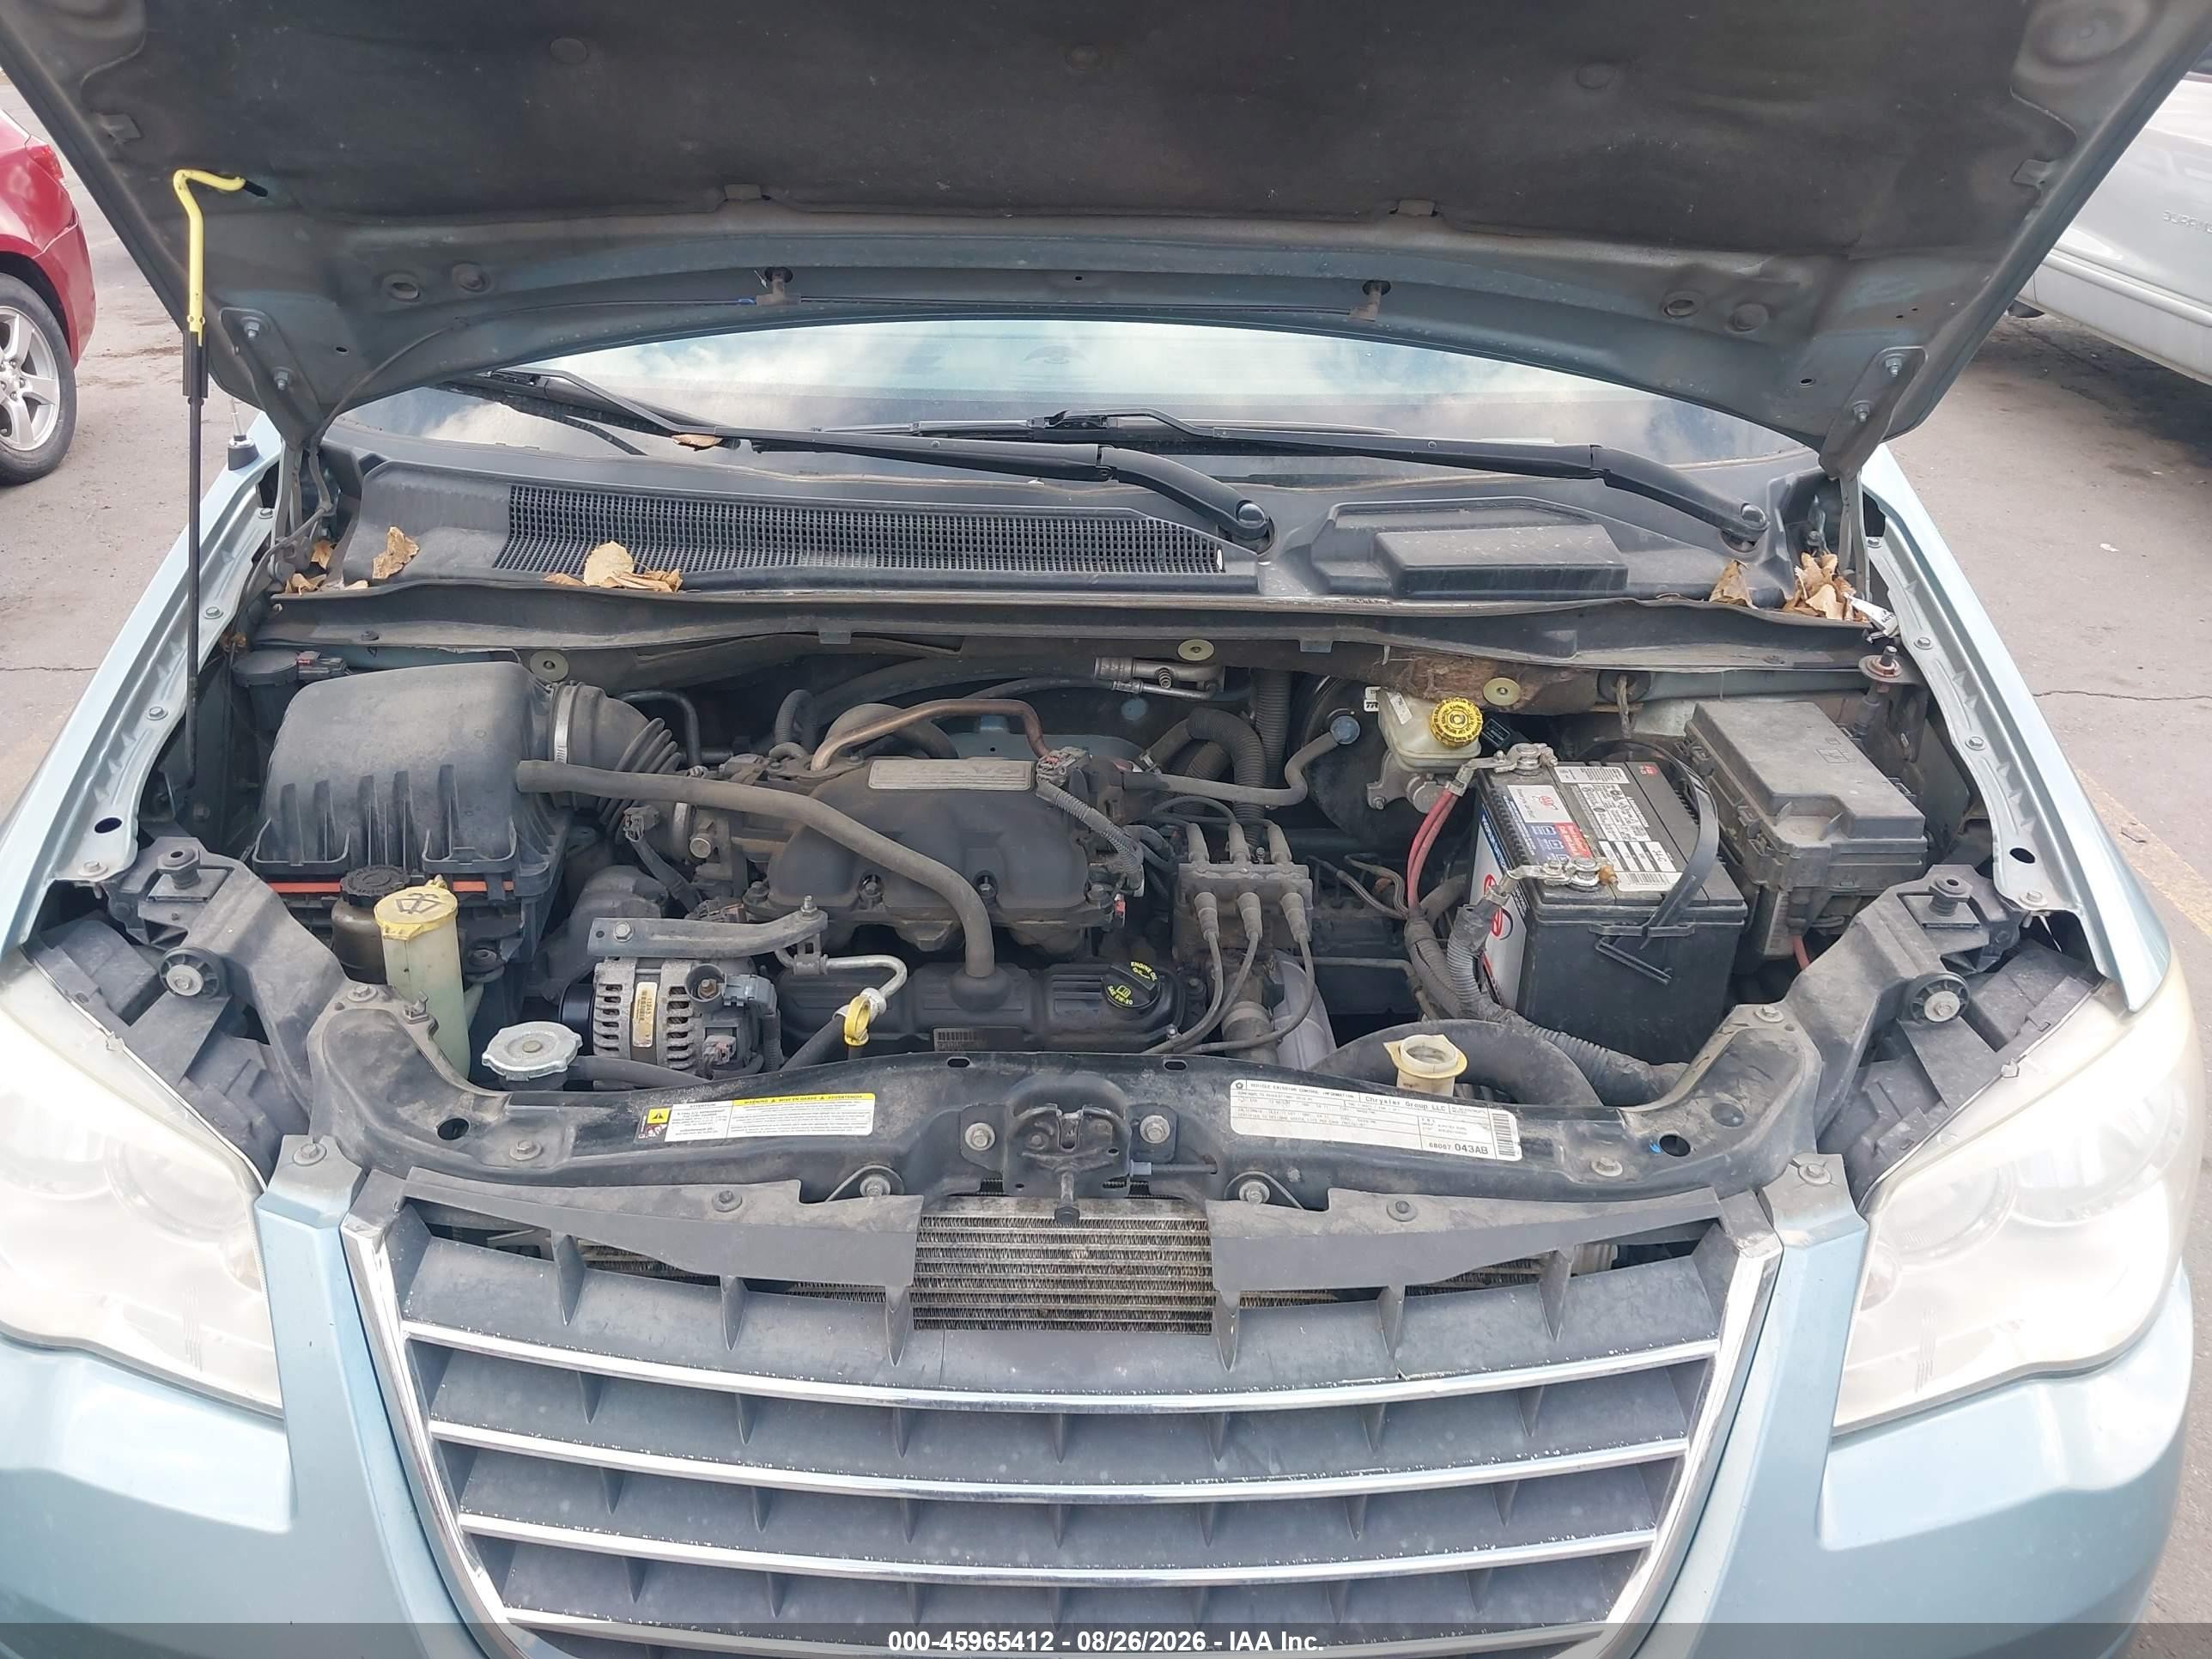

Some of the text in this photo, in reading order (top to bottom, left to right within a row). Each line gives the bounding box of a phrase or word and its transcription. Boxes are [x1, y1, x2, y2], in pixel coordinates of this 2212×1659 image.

[1130, 961, 1152, 974] ENGINE
[1115, 994, 1133, 1006] 5W-20
[1365, 1096, 1401, 1105] Chrysler
[1455, 1143, 1489, 1154] 043AB
